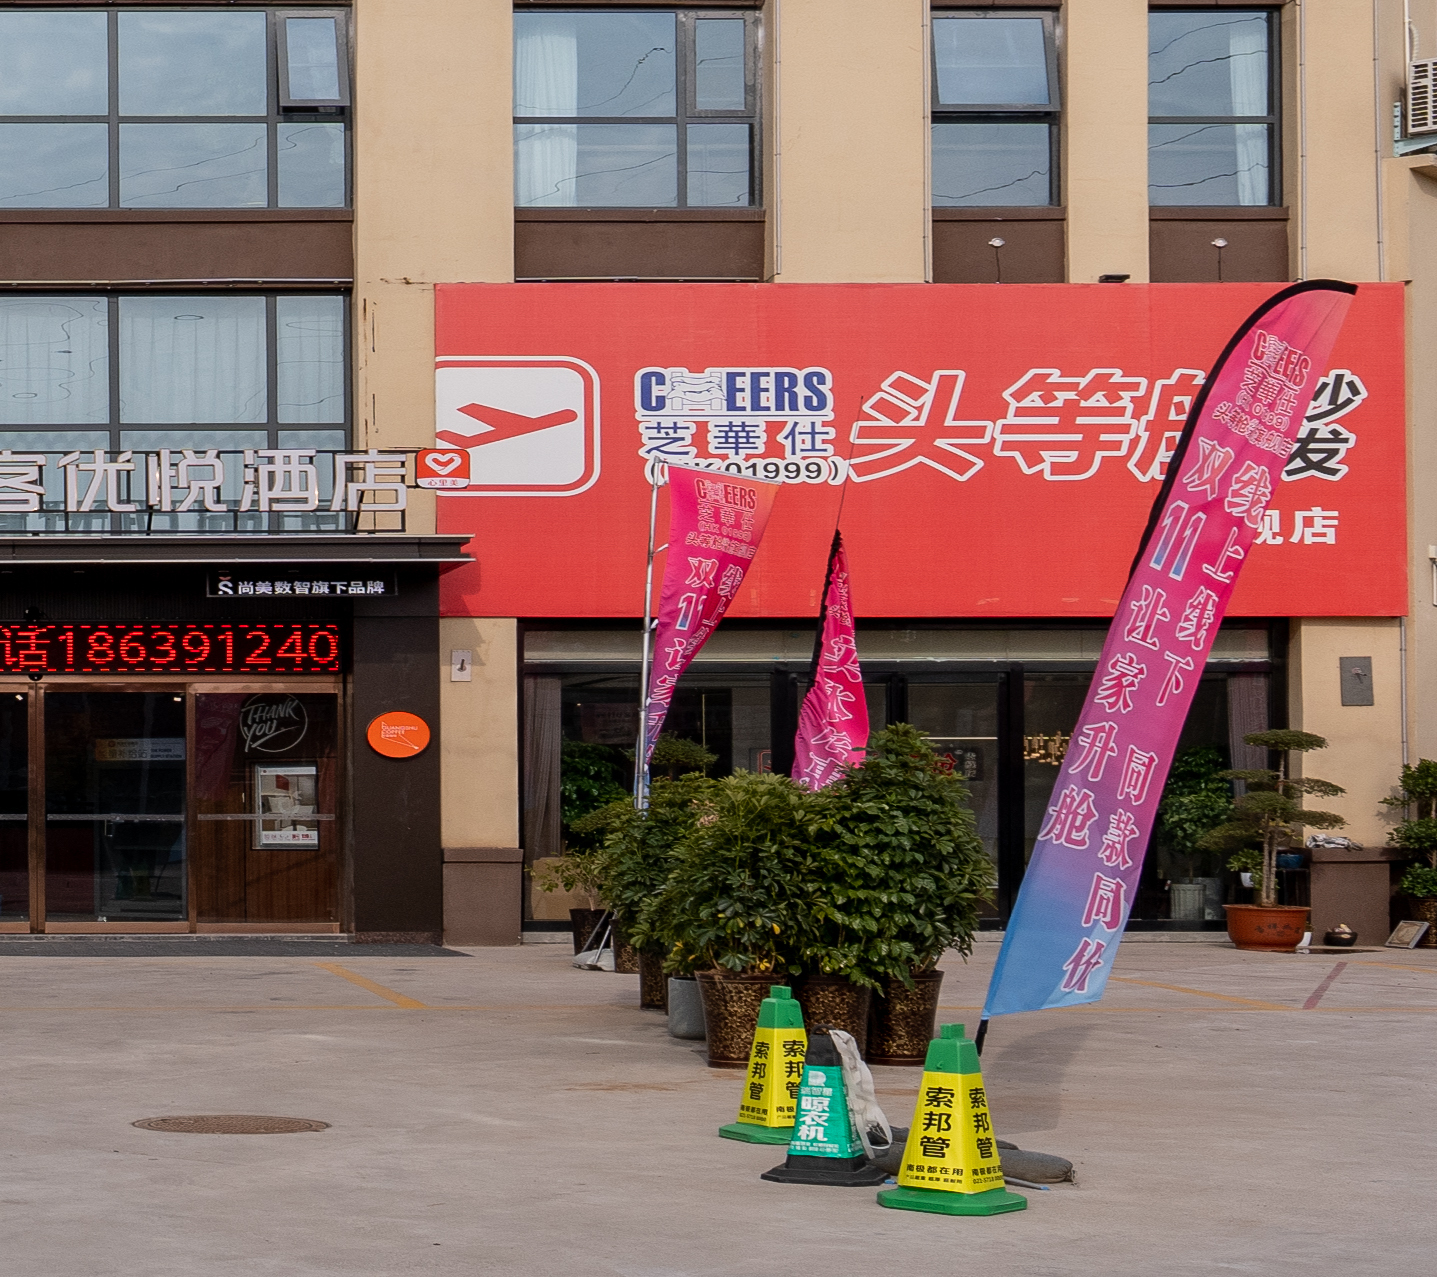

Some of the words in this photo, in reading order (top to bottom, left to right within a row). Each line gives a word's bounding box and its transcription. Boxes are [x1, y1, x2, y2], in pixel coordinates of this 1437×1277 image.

[238, 580, 385, 596] 尚美数智旗下品牌
[749, 1041, 770, 1101] 索邦管
[797, 1096, 831, 1142] 晾衣机
[920, 1086, 955, 1159] 索邦管
[969, 1087, 994, 1159] 索邦管
[906, 1163, 964, 1176] 南极都在用
